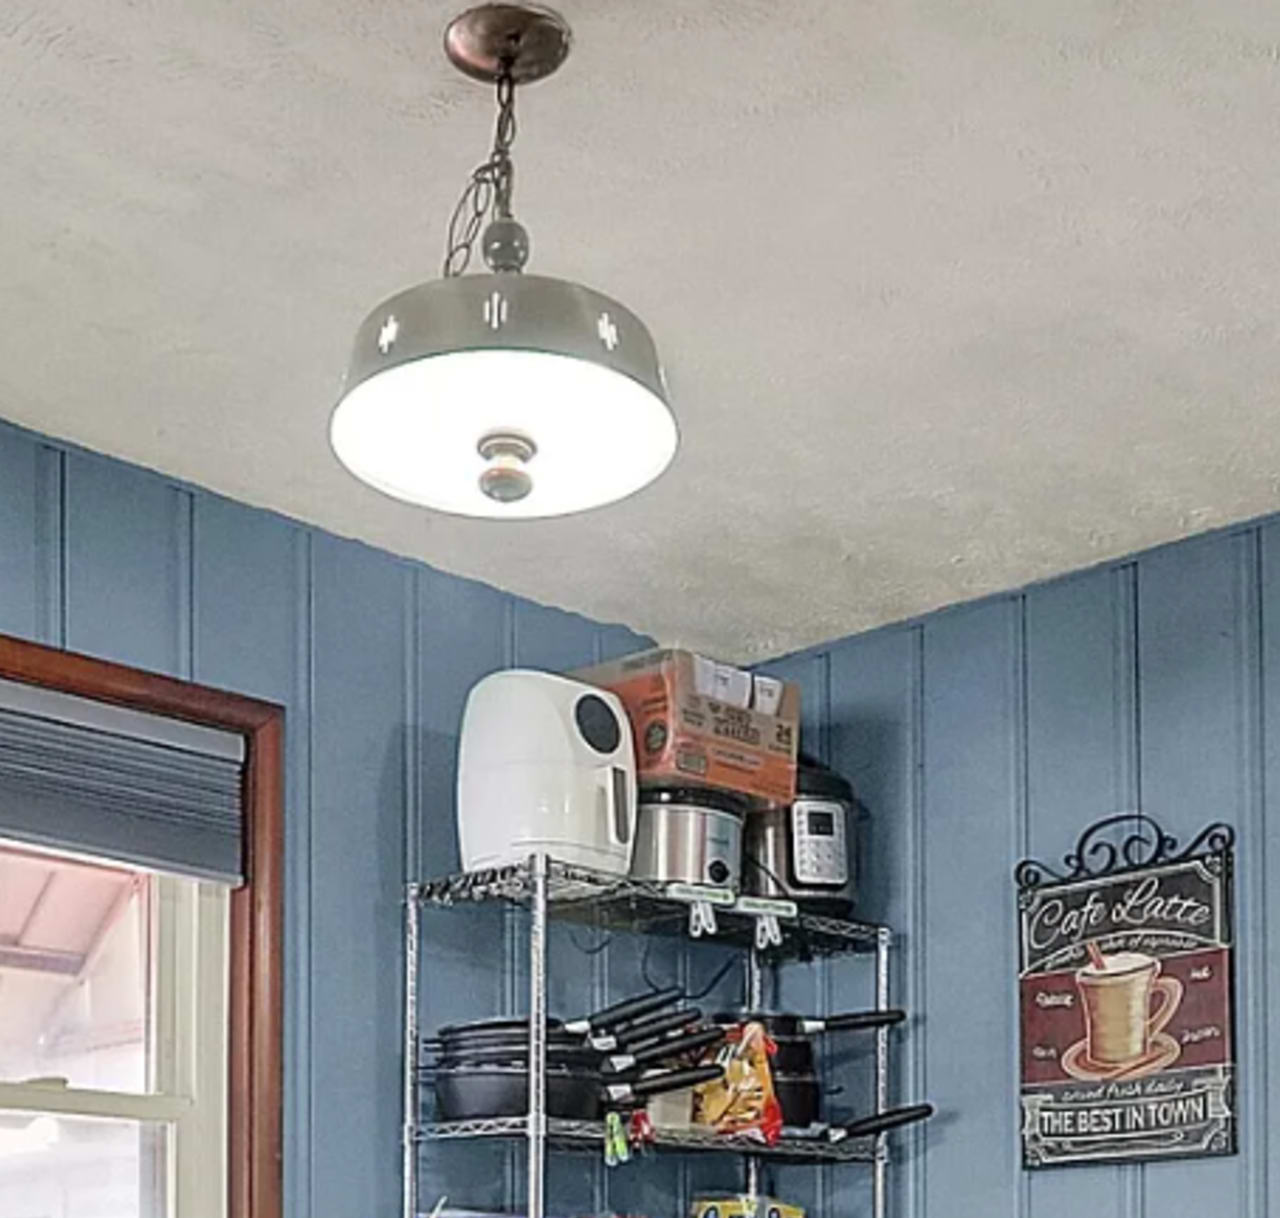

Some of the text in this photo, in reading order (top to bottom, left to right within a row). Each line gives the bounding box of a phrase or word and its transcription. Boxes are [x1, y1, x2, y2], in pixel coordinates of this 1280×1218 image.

[1030, 876, 1211, 949] Cafe Latte
[1040, 1096, 1205, 1135] THE BEST IN TOWN
